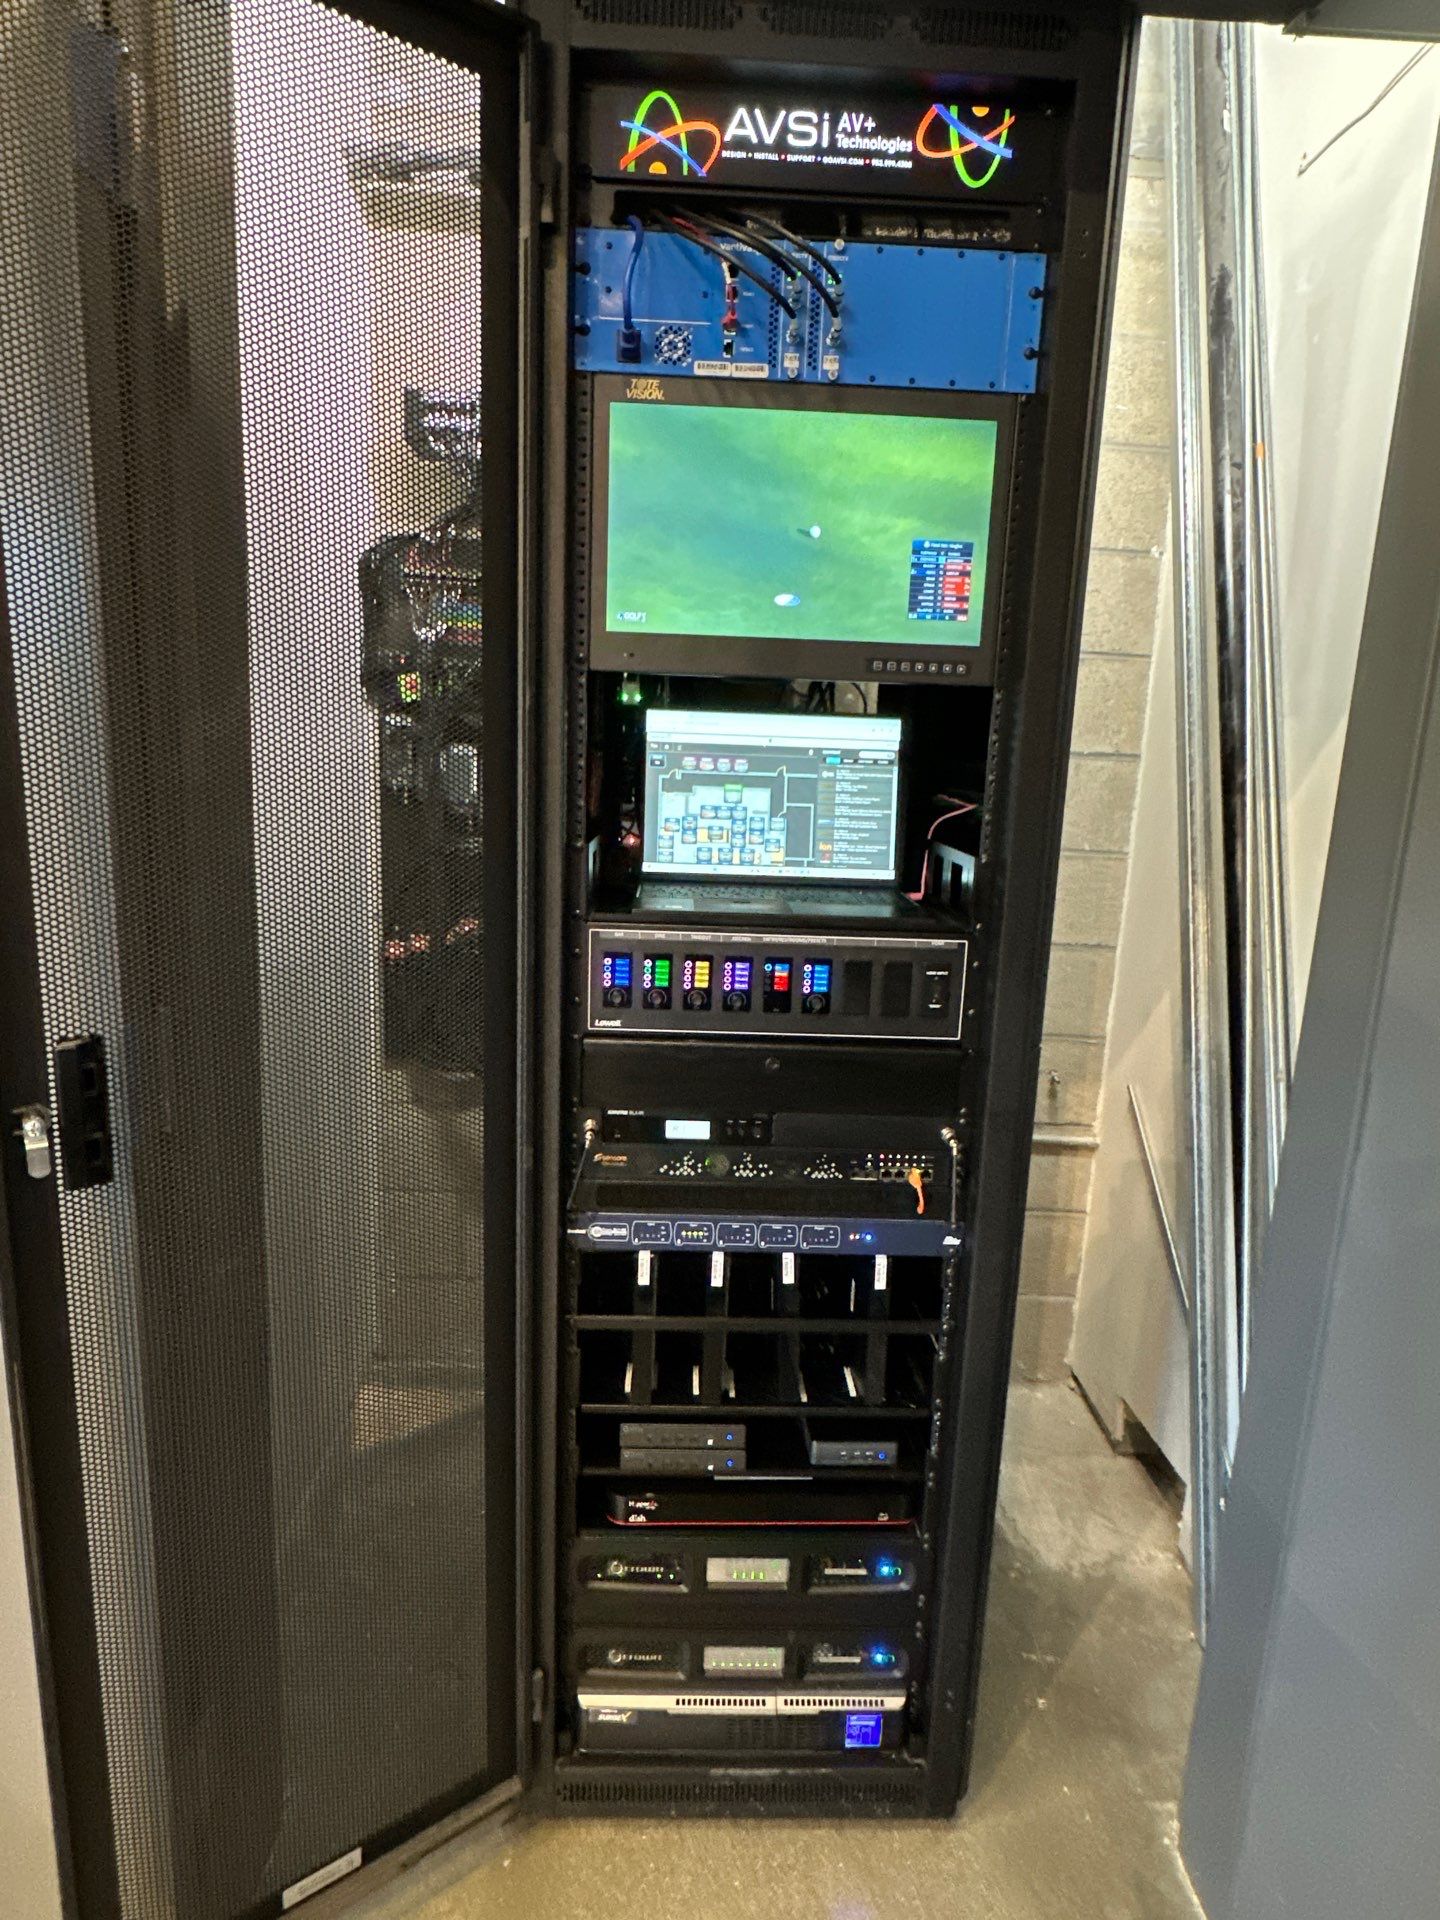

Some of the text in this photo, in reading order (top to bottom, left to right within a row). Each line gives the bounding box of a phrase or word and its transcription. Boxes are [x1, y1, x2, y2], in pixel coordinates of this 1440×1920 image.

[724, 107, 830, 148] AVSi
[837, 112, 876, 133] AV+
[835, 133, 913, 154] Technologies
[721, 150, 747, 159] DESIGN
[753, 152, 779, 161] INSTALL
[786, 154, 815, 163] SUPPORT
[594, 1019, 622, 1027] Lowell
